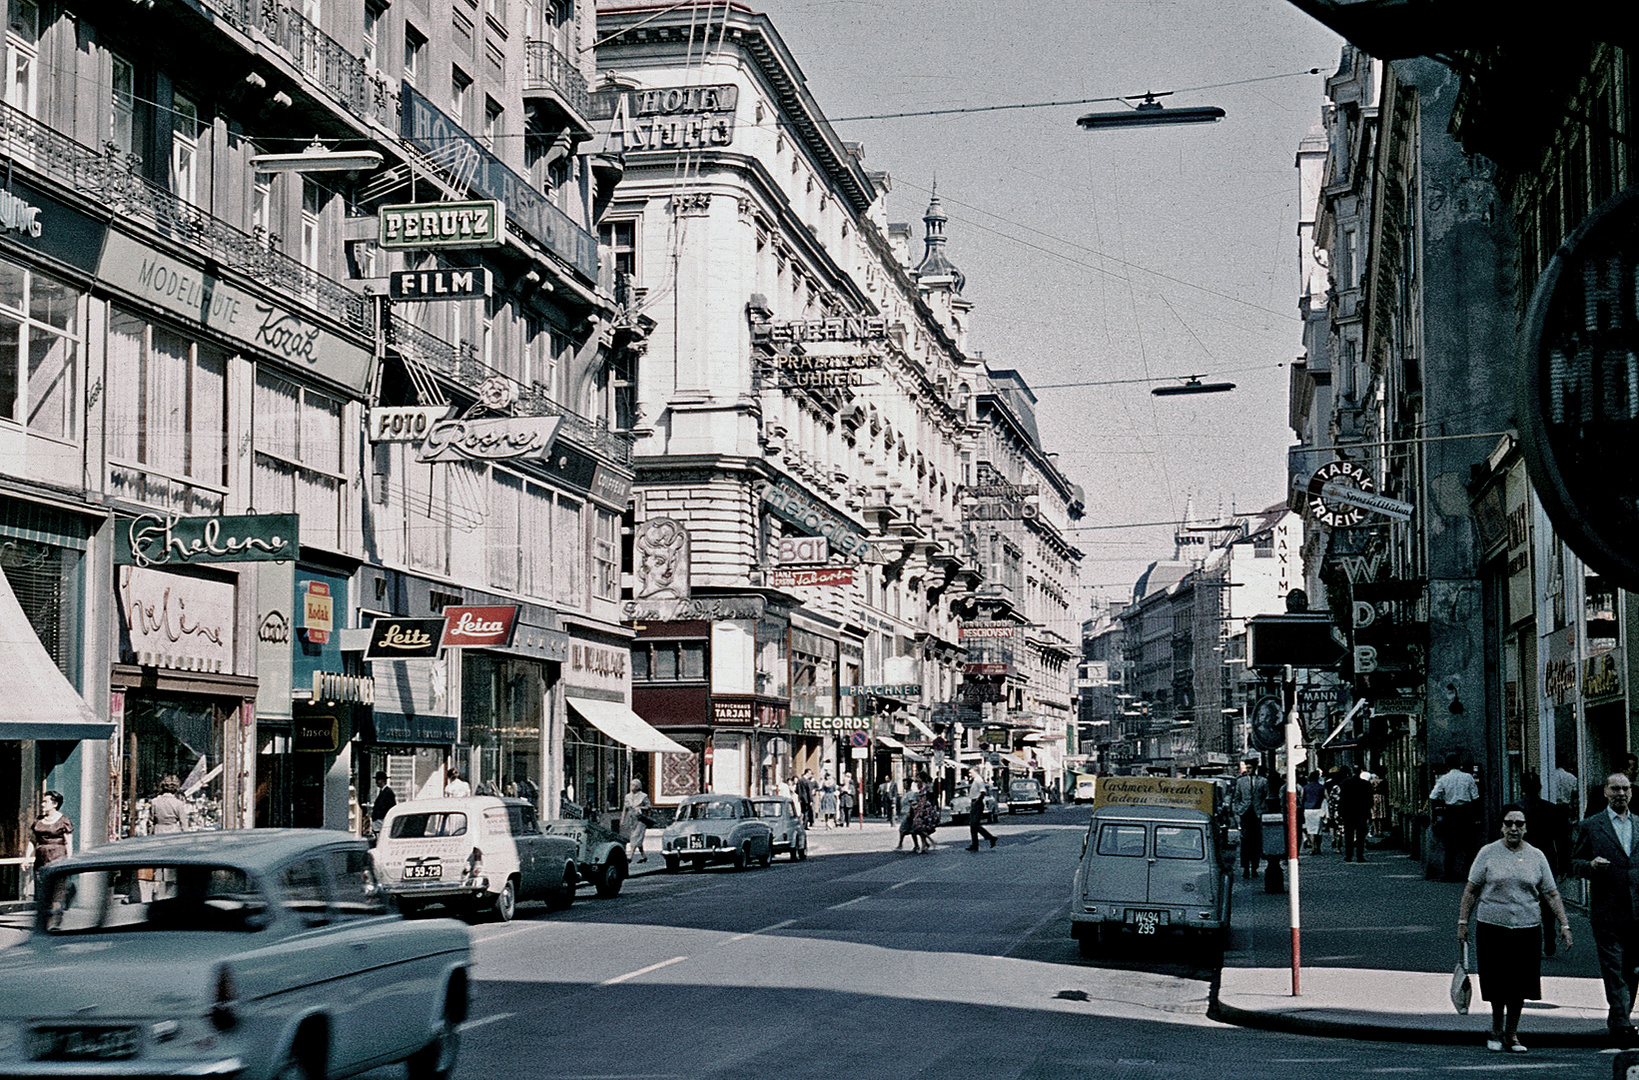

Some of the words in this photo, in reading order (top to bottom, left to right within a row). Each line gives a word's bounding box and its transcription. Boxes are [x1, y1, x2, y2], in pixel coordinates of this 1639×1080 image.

[386, 210, 489, 238] PERUTZ
[401, 272, 473, 295] FILM
[380, 412, 427, 435] FOTO
[1317, 462, 1374, 491] TABAK
[968, 502, 1038, 519] KINO
[1309, 497, 1364, 527] TRAFIK
[779, 539, 826, 561] Bar
[1277, 525, 1289, 592] MAXIM
[307, 603, 329, 621] Kodak
[378, 624, 432, 650] Leitz
[451, 612, 504, 637] Leica
[849, 685, 920, 696] PRACHNER
[714, 709, 751, 718] TARJAN
[803, 717, 870, 729] RECORDS
[1102, 779, 1155, 794] Cashmere
[1157, 781, 1204, 795] Sweaters
[1135, 911, 1159, 924] W494
[1138, 922, 1155, 934] 295
